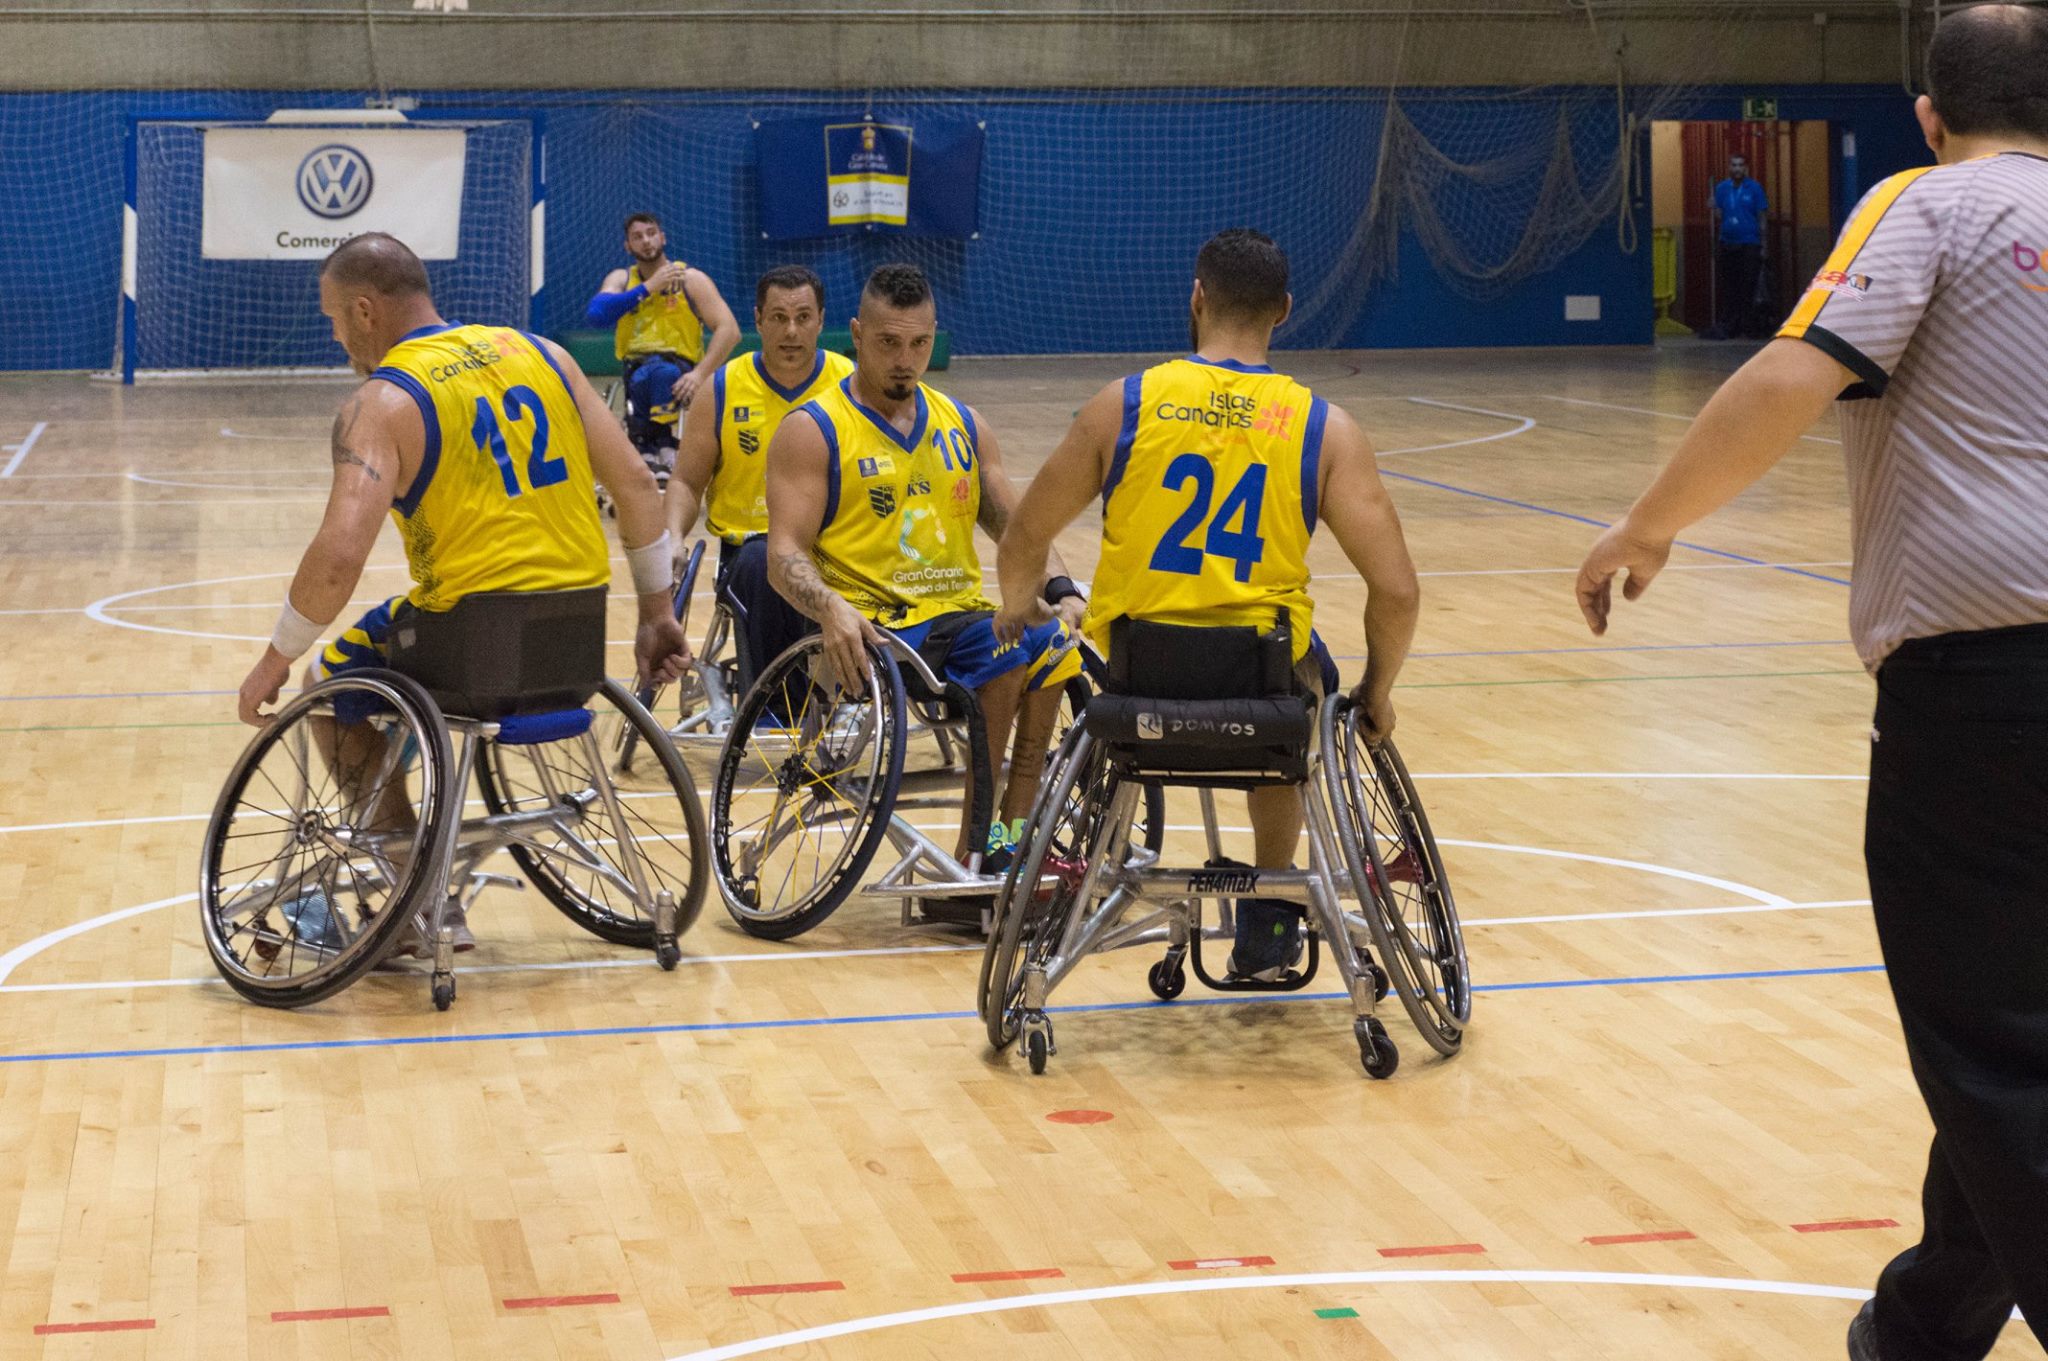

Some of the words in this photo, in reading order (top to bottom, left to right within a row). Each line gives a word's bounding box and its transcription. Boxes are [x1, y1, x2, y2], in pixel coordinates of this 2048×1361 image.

[276, 231, 352, 248] Comerc
[1210, 391, 1255, 411] Islas
[1157, 403, 1253, 428] Canarias
[471, 385, 569, 497] 12
[932, 428, 972, 473] 10
[1149, 453, 1268, 583] 24
[893, 571, 924, 583] Gran
